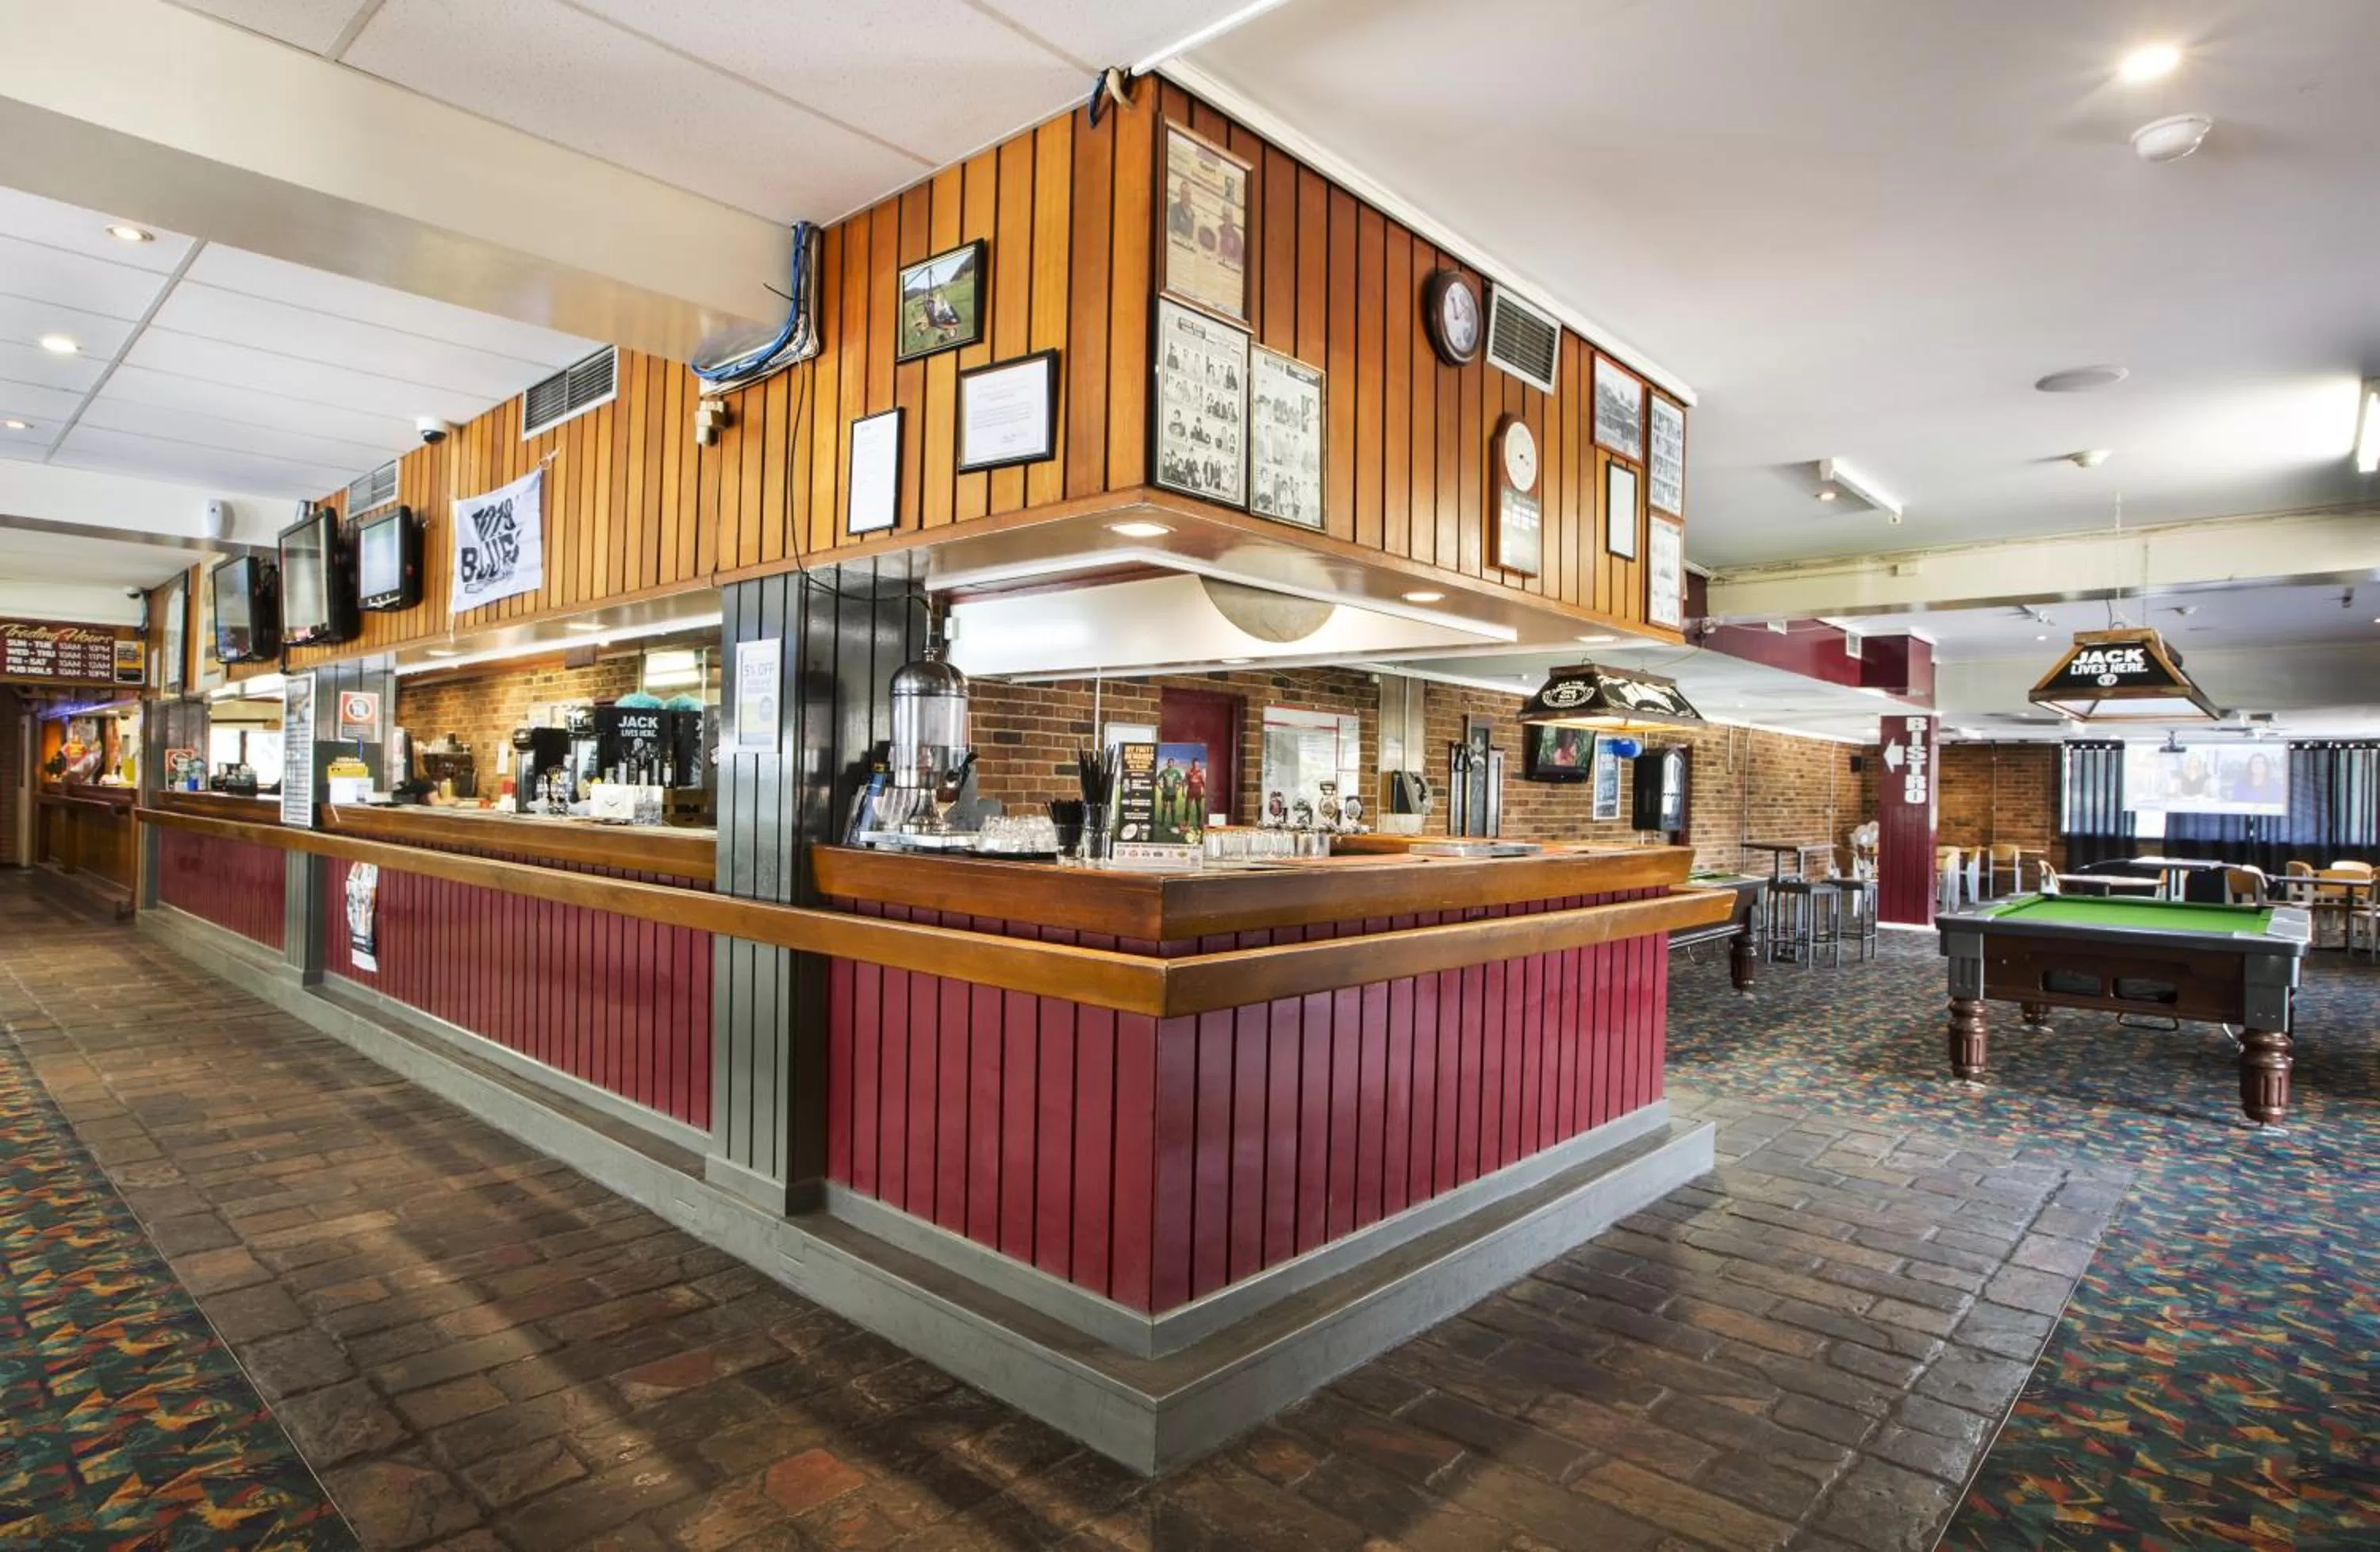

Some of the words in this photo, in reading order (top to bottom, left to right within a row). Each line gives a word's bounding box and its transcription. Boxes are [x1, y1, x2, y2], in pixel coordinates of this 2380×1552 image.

[0, 623, 59, 643] Trading
[56, 628, 114, 644] Hours
[6, 639, 27, 647] SUN
[34, 640, 53, 650] TUE
[58, 642, 81, 651] 10AM
[88, 644, 111, 653] 10PM
[6, 647, 29, 657] WED
[36, 649, 56, 659] THU
[58, 651, 81, 660] 10AM
[88, 653, 111, 662] 11PM
[2071, 647, 2145, 665] JACK
[6, 656, 23, 665] FRI
[29, 658, 48, 667] SAT
[58, 659, 81, 669] 10AM
[2070, 663, 2108, 675] LIVES
[2109, 663, 2149, 674] HERE.
[6, 665, 27, 674] PUB
[27, 666, 54, 675] HOLS
[58, 667, 81, 677] 10AM
[617, 715, 659, 730] JACK
[621, 729, 639, 738] LIVES
[1905, 716, 1928, 804] BISTRO
